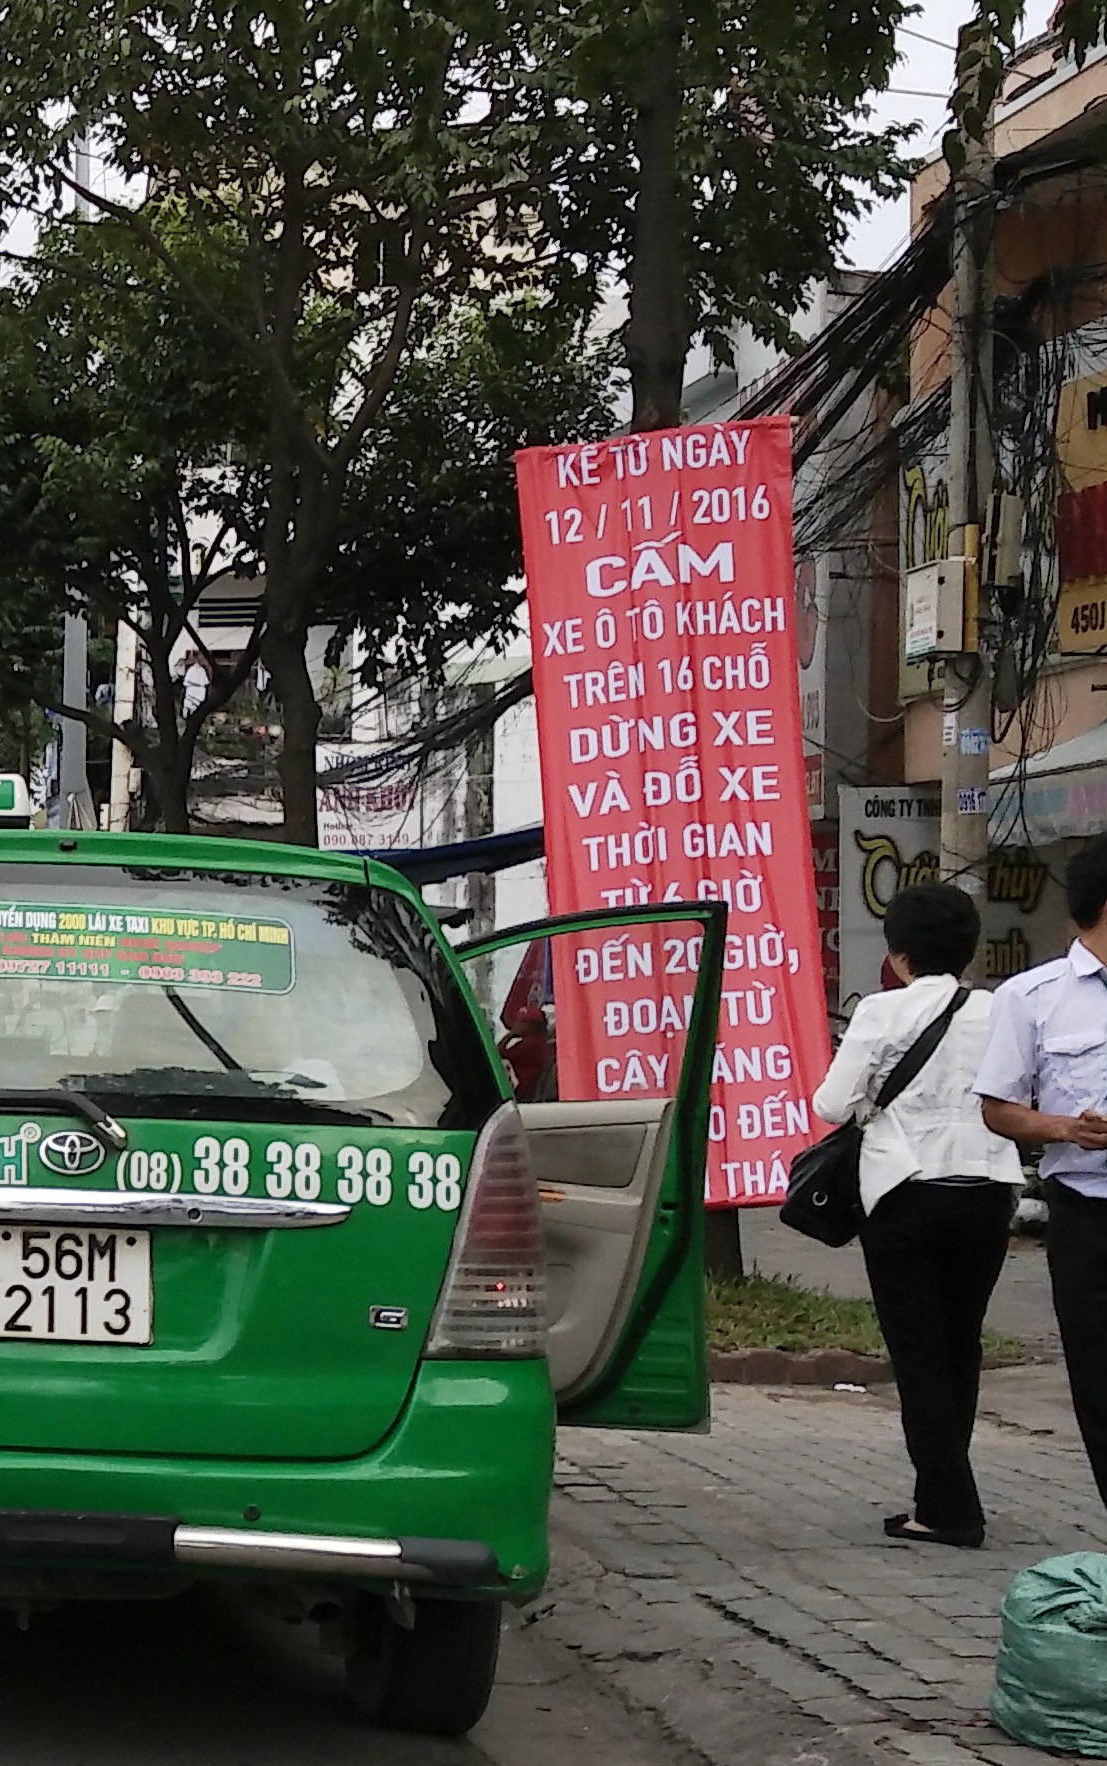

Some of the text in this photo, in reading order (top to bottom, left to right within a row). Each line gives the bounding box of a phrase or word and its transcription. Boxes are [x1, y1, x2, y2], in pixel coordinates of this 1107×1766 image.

[609, 434, 651, 480] TỪ
[661, 423, 751, 472] NGÀY
[545, 508, 584, 545] 12
[620, 496, 653, 532] 11
[691, 485, 771, 525] 2016
[585, 531, 736, 598] CẤM
[542, 592, 786, 657] XE Ô TÔ KHÁCH
[563, 641, 771, 709] TRÊN 16 CHỖ
[569, 714, 697, 764] DỪNG
[712, 709, 775, 747] XE
[568, 769, 632, 818] VÀ
[643, 754, 702, 807] ĐỖ
[718, 765, 782, 801] XE
[581, 821, 774, 872] THỜI GIAN
[600, 877, 653, 909] TỪ
[697, 868, 764, 913] GIỜ
[58, 913, 86, 929] 2000
[88, 912, 106, 931] LÁI
[108, 915, 124, 932] XE
[125, 915, 149, 934] TAXI
[151, 917, 175, 936] KHU
[176, 918, 199, 940] VỰC
[575, 933, 653, 984] ĐẾN
[723, 922, 801, 975] GIỜ,
[721, 981, 778, 1027] TỪ
[597, 1041, 793, 1094] CÂY ĂNG
[736, 1089, 810, 1140] ĐẾN
[116, 1151, 182, 1194] (08)
[194, 1136, 250, 1196] 38
[265, 1141, 321, 1200] 38
[337, 1146, 392, 1206] 38
[407, 1151, 461, 1212] 38
[720, 1149, 791, 1199] THÁ
[21, 1231, 117, 1283] 56M
[4, 1284, 131, 1336] 2113
